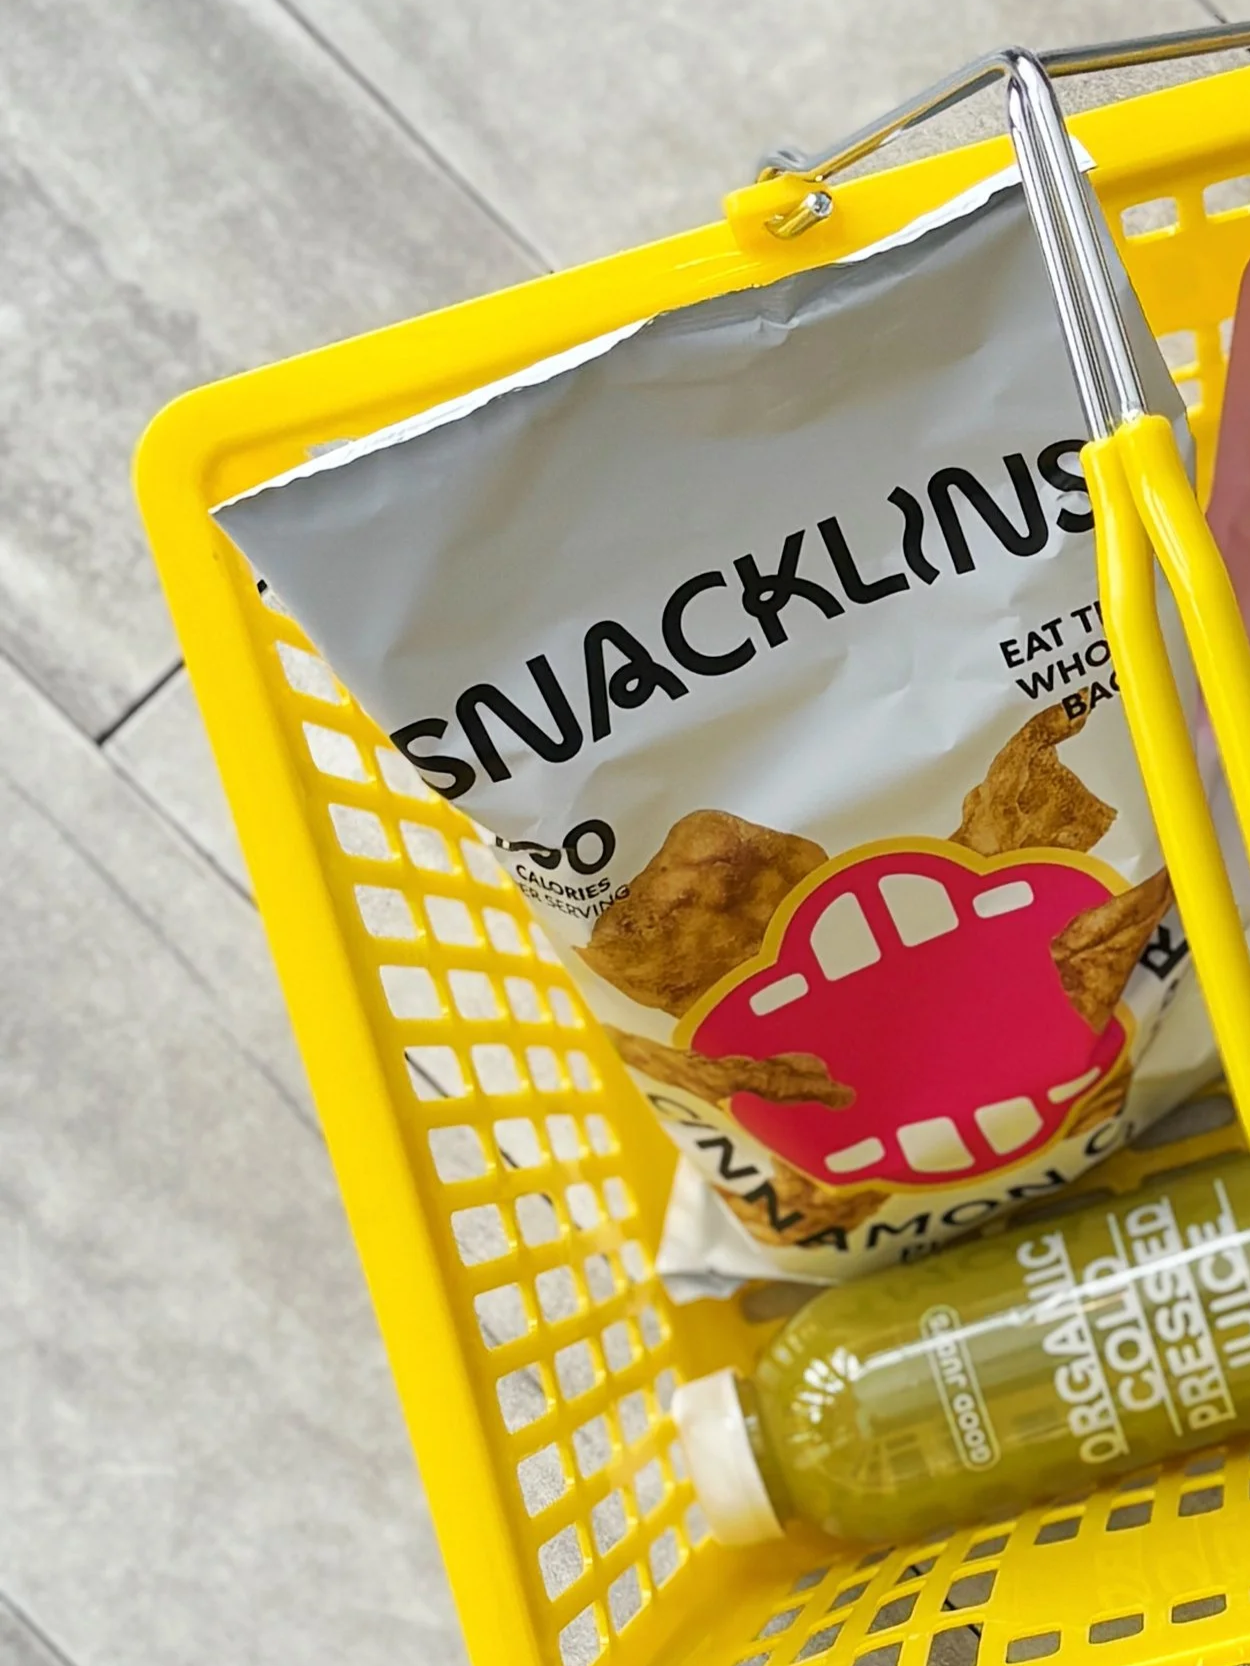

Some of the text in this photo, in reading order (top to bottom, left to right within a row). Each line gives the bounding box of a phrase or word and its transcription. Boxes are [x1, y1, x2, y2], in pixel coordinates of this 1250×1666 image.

[391, 439, 1096, 800] SNACKLINS
[999, 617, 1065, 669] EAT
[516, 863, 612, 899] CALORIES
[544, 884, 632, 922] SERVING
[648, 1092, 1071, 1255] CINNAMON
[1018, 1230, 1125, 1465] ORGANIC
[1083, 1254, 1166, 1414] COLD
[1126, 1197, 1236, 1431] PRESSED
[944, 1402, 991, 1467] GOOD
